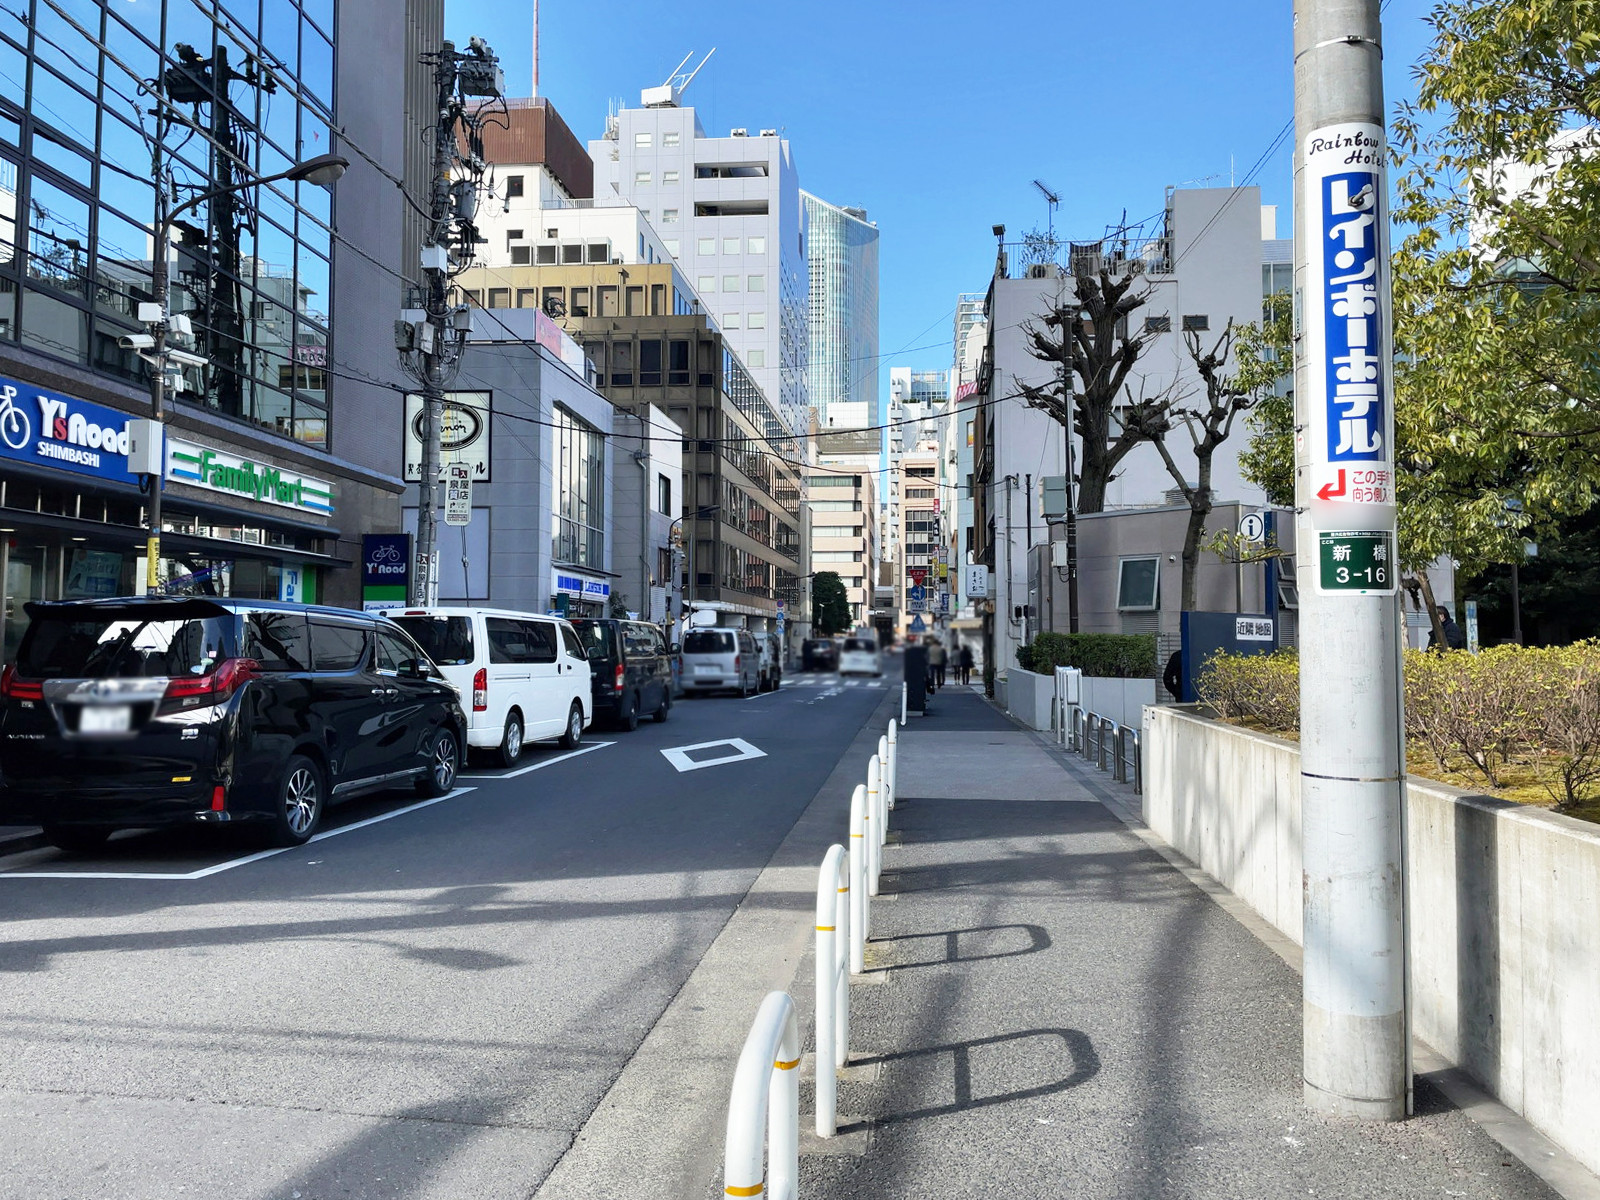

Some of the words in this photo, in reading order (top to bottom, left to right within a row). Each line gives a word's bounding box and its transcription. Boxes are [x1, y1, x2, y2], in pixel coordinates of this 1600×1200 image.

[1309, 131, 1379, 156] Rainbow
[1344, 150, 1386, 168] Hotel
[1329, 179, 1382, 455] レインボーホテル
[37, 441, 100, 468] SHIMBASHI
[201, 450, 304, 502] FamilyMart
[1333, 544, 1387, 562] 新橋
[1335, 566, 1386, 584] 3-16
